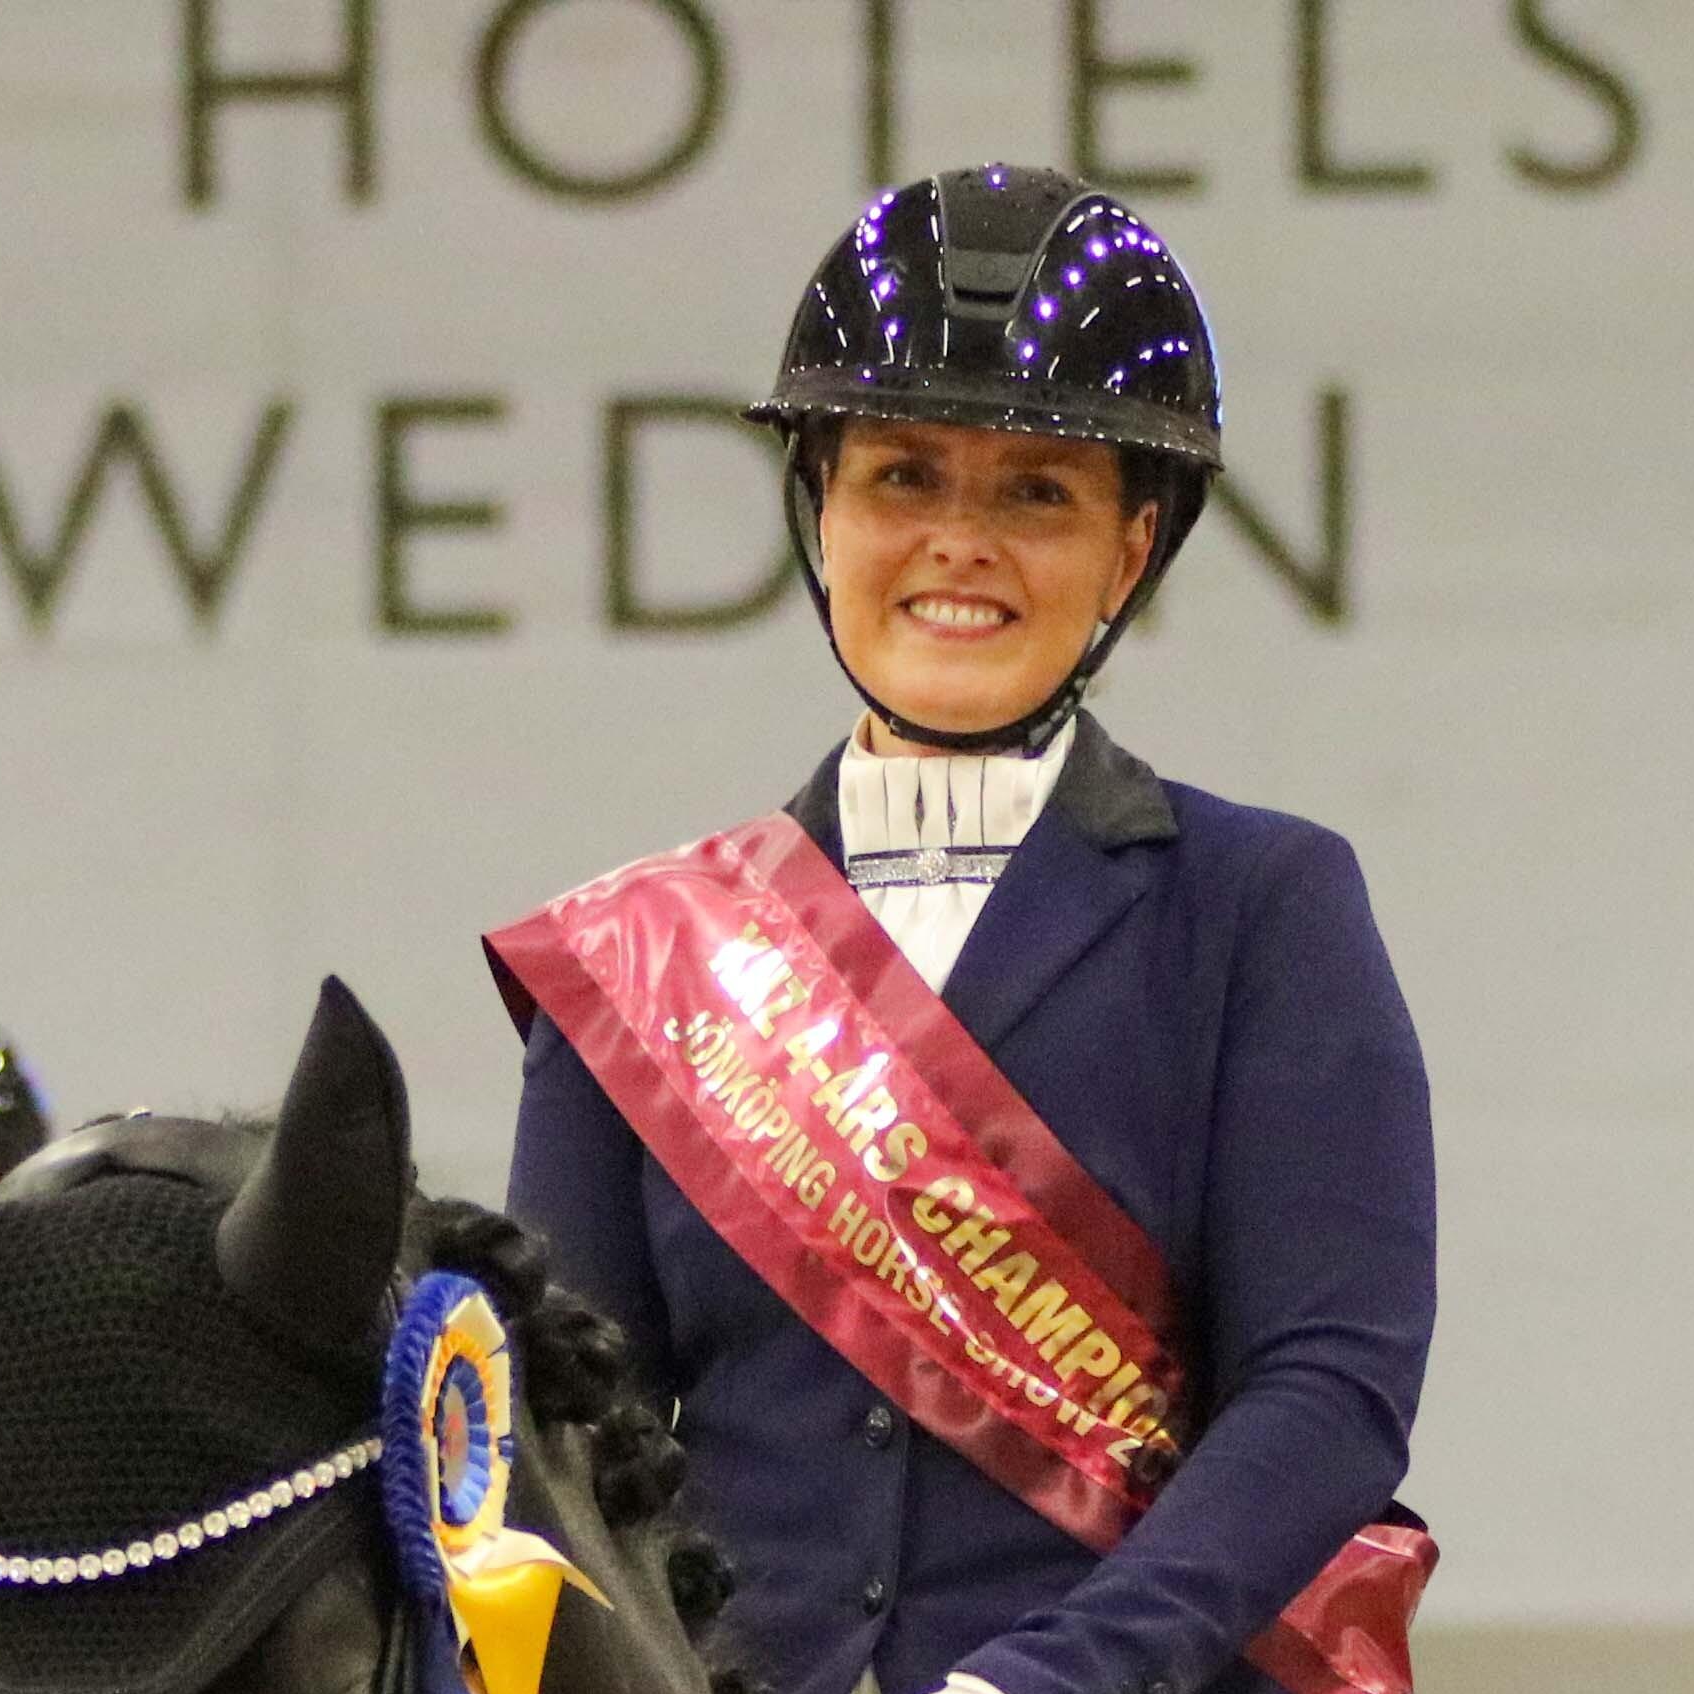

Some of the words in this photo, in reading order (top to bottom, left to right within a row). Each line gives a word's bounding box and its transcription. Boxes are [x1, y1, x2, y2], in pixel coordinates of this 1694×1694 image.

[663, 1009, 837, 1212] JÖNKÖPING
[826, 1189, 962, 1336] HORSE
[911, 1175, 1179, 1436] CHAMPIO
